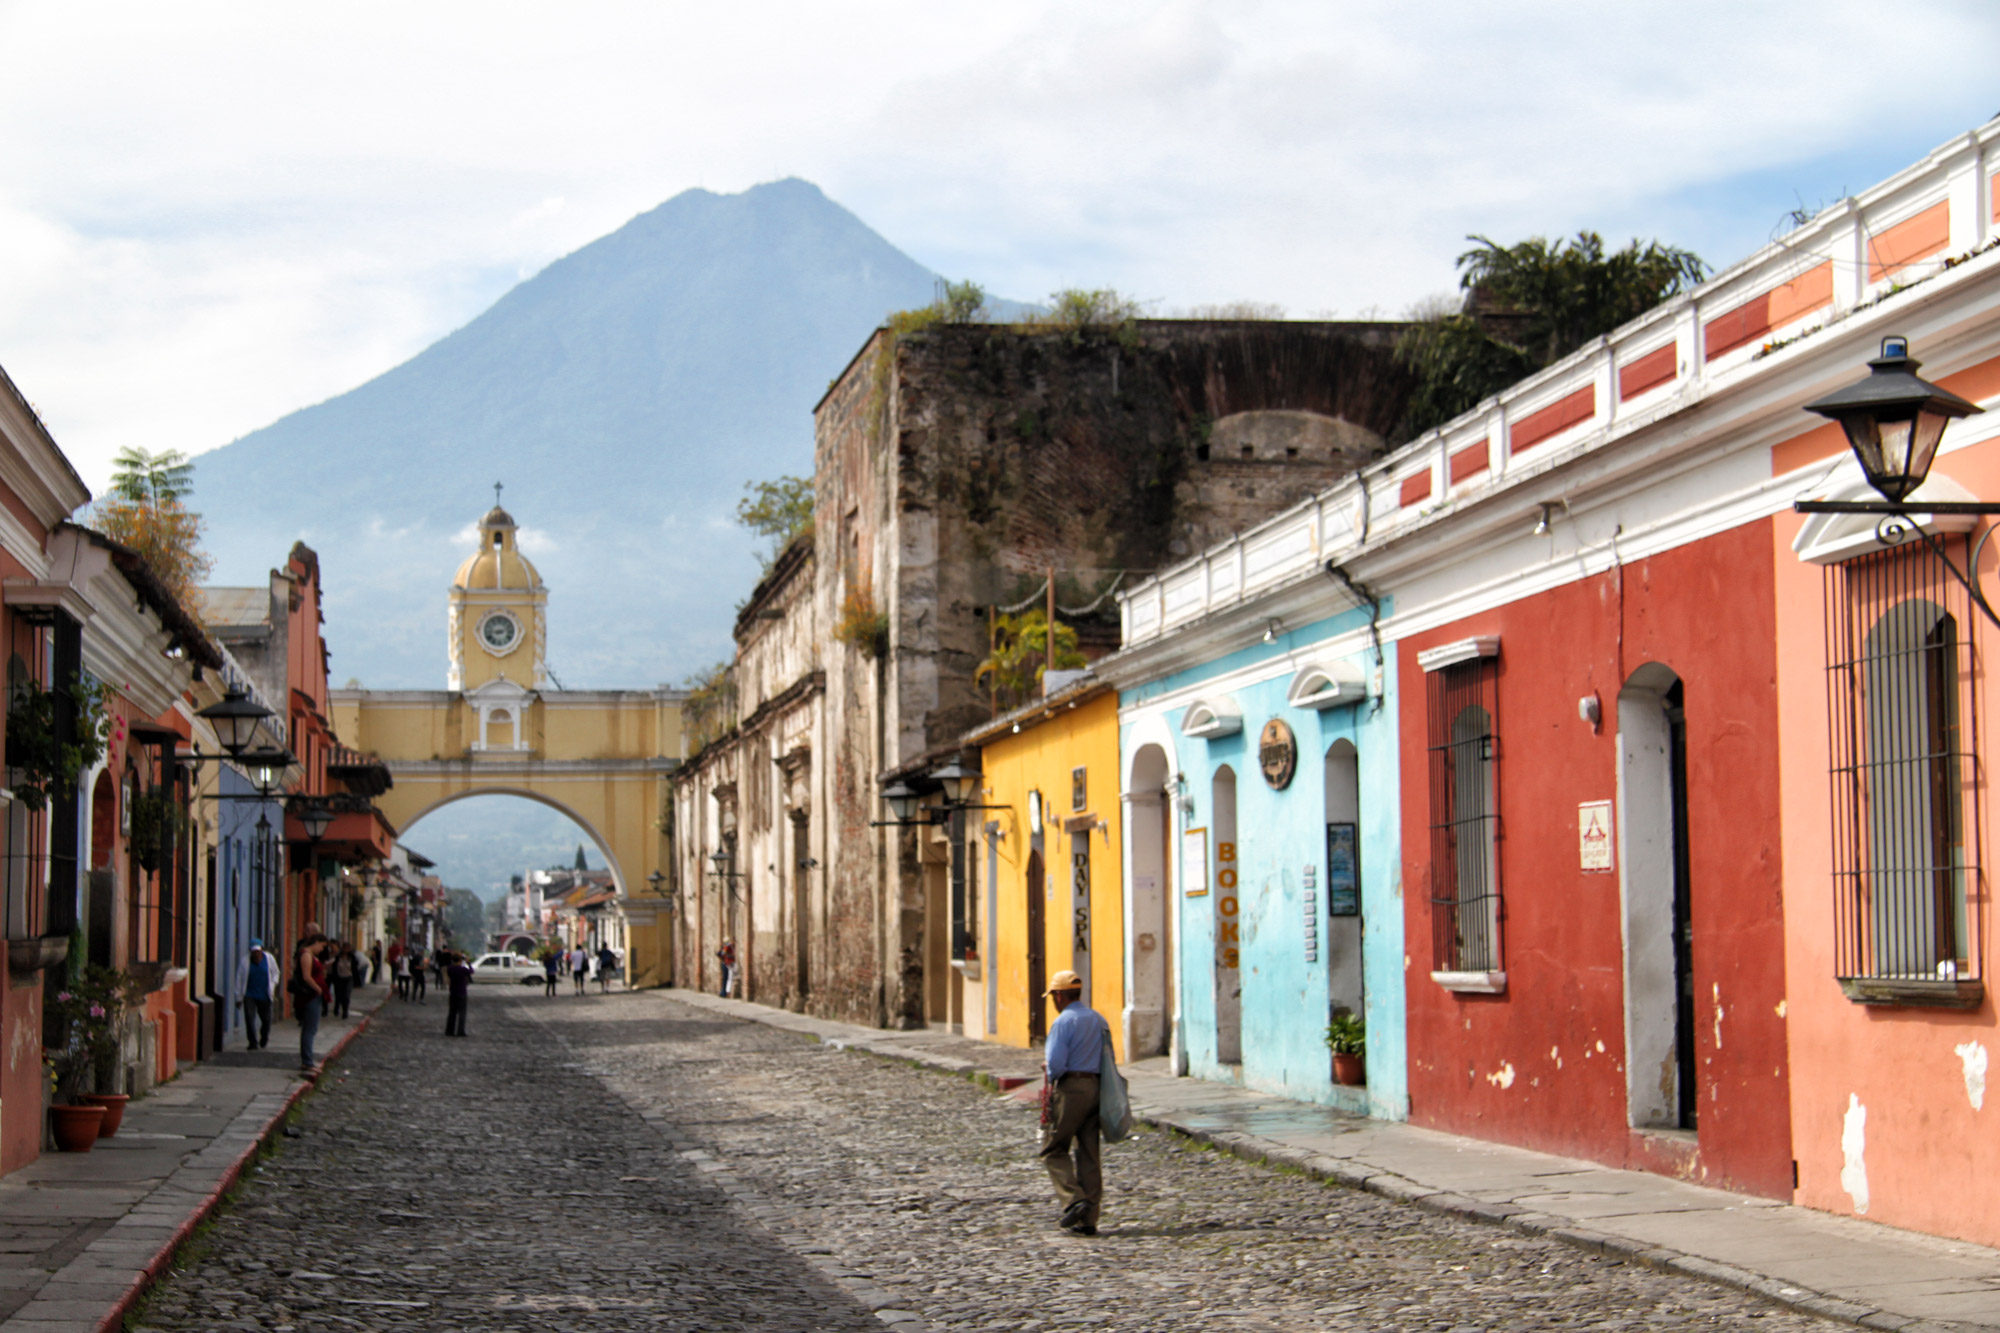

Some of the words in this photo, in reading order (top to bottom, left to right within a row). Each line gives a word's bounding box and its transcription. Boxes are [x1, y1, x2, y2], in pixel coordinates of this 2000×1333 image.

[1074, 853, 1088, 897] DAY
[1218, 842, 1239, 969] BOOKS
[1074, 907, 1088, 952] SPA
